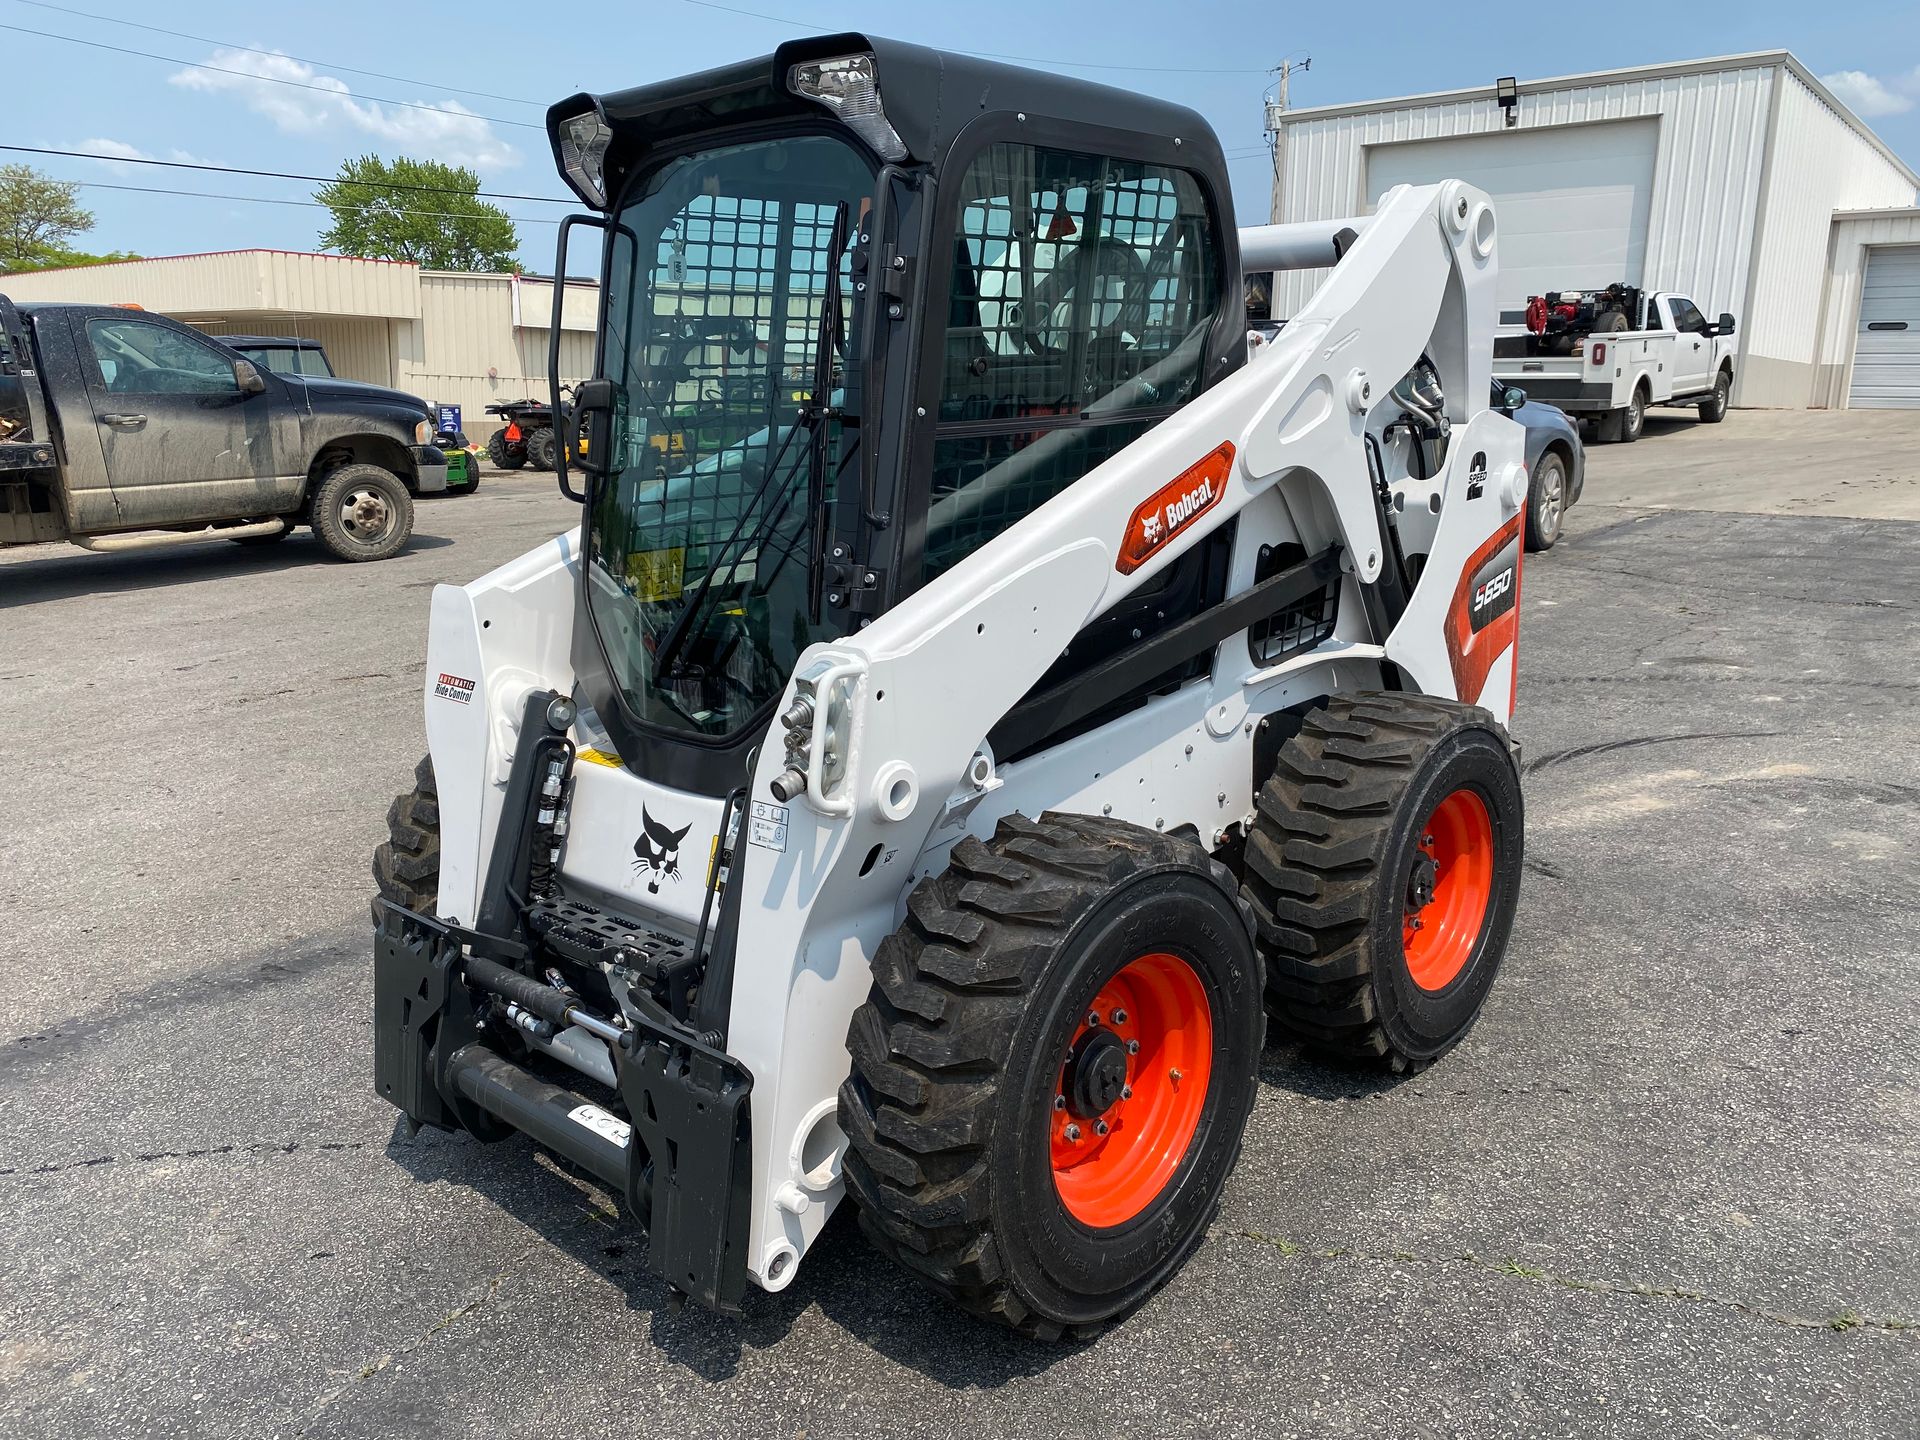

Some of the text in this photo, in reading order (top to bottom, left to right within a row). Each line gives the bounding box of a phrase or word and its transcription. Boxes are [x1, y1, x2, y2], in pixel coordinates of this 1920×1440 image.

[1468, 471, 1488, 485] SPEED
[1165, 476, 1213, 529] Bobcat
[1473, 567, 1512, 612] S650
[440, 675, 475, 690] AUTOMATIC
[435, 684, 472, 702] Ride Control
